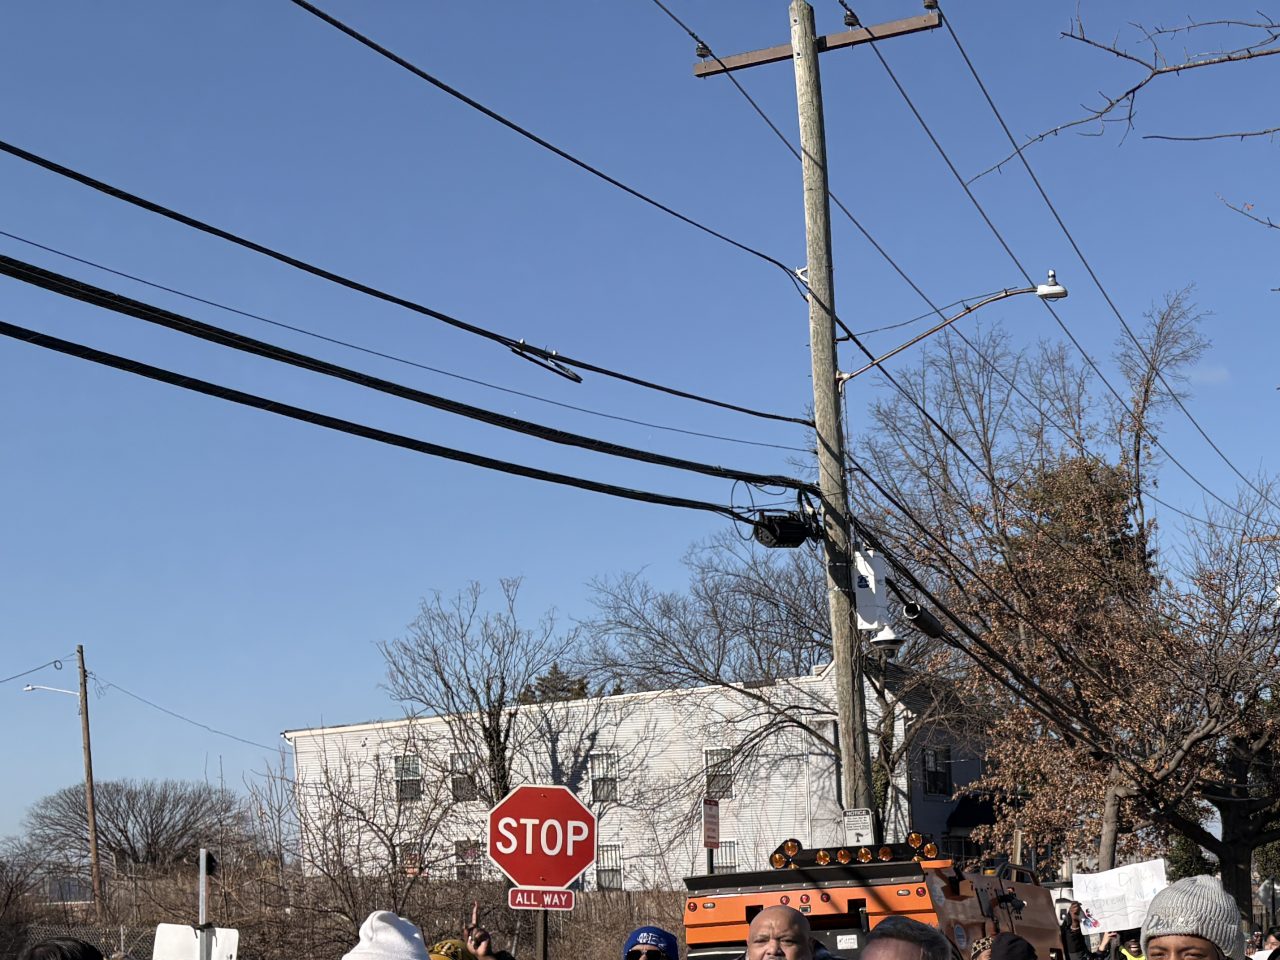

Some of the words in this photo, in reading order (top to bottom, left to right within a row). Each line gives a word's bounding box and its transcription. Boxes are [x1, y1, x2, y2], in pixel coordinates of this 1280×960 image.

[496, 817, 589, 856] STOP
[516, 892, 538, 905] ALL
[543, 893, 568, 906] WAY
